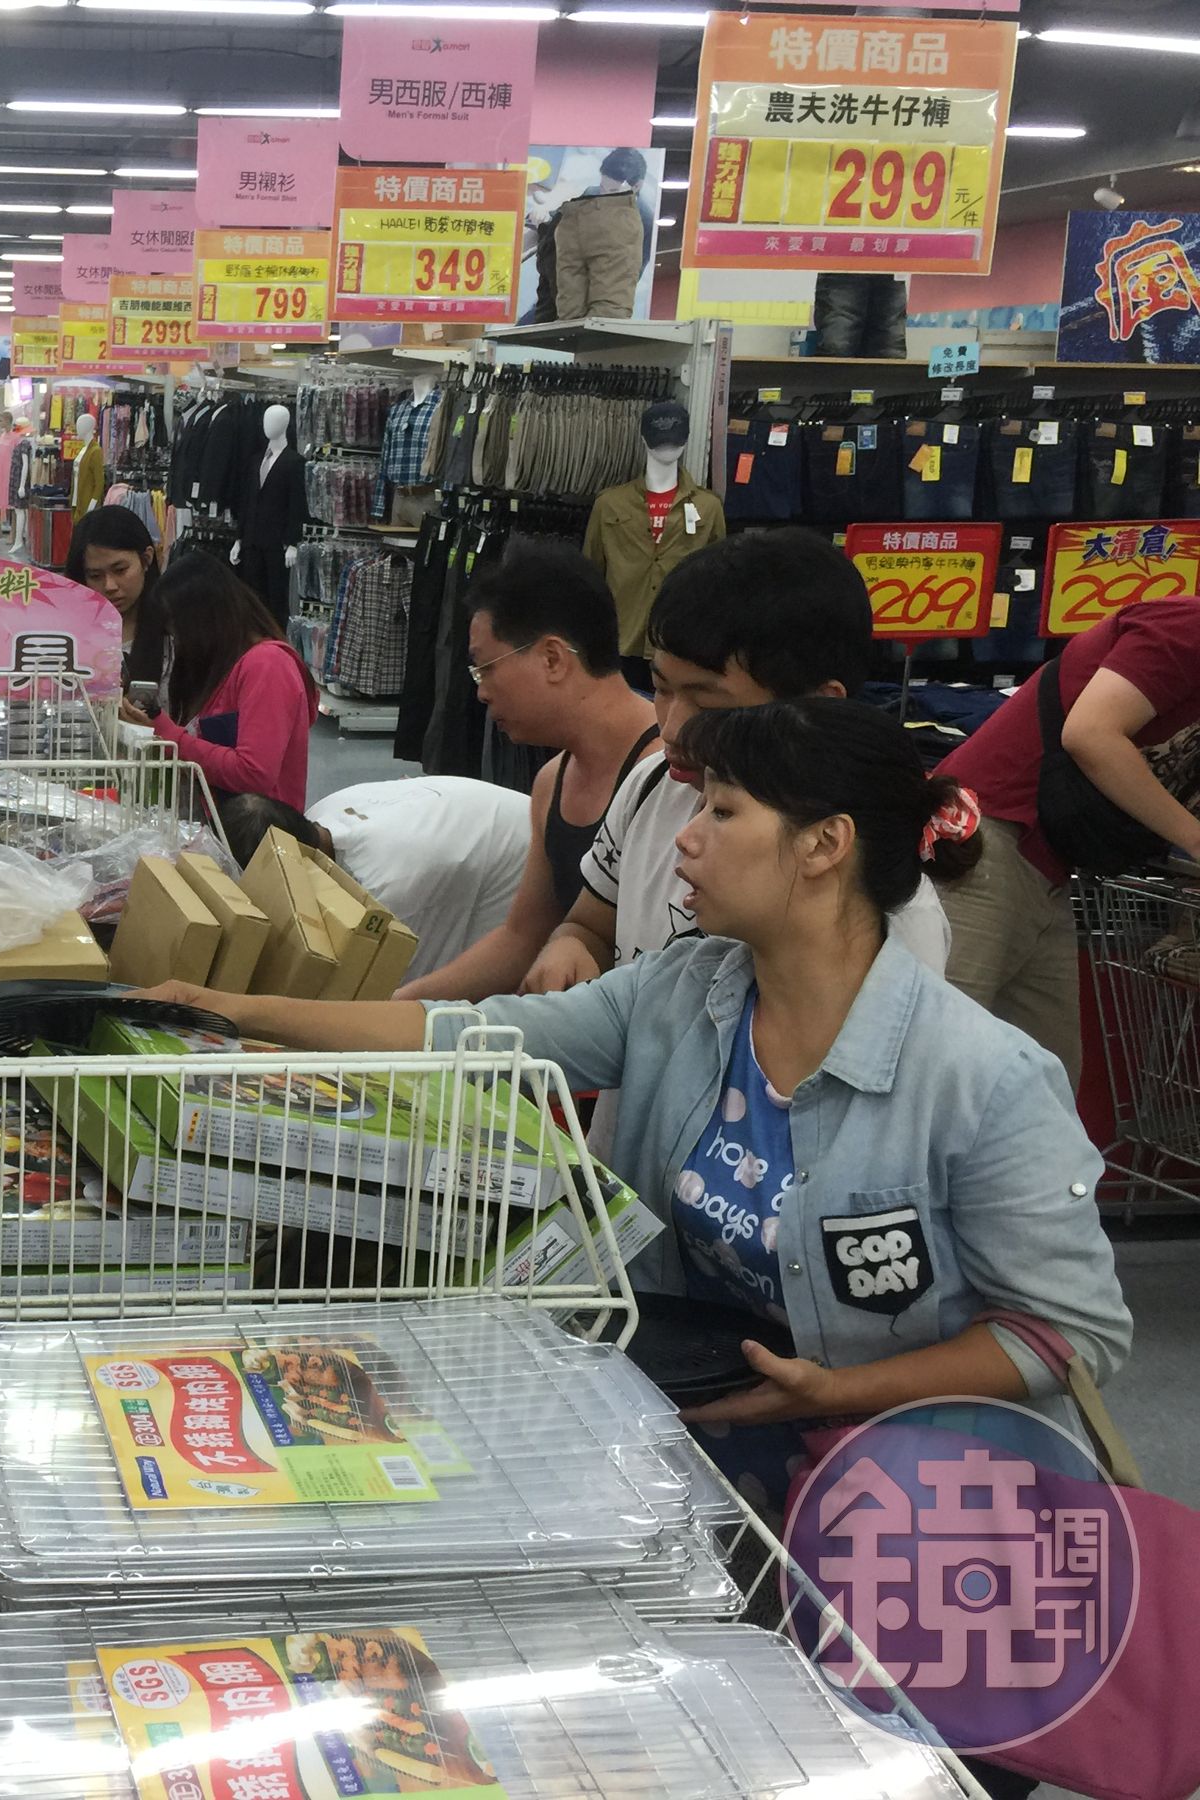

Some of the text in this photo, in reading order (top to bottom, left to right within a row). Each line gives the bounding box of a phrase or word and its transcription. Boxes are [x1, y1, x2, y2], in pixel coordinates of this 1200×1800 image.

[769, 27, 949, 75] 特價商品
[368, 78, 512, 110] 男西服/西褲
[765, 91, 951, 128] 農夫洗牛仔褲
[387, 110, 469, 121] Men's Formal Suit
[239, 171, 296, 192] 男襯衫
[374, 176, 484, 203] 特價商品
[828, 149, 946, 221] 299
[224, 235, 304, 255] 特價商品
[415, 248, 485, 292] 349
[256, 287, 306, 319] 799
[883, 532, 958, 550] 特價商品
[868, 575, 976, 629] 269
[848, 1257, 920, 1298] DAY
[128, 1665, 168, 1703] SGS
